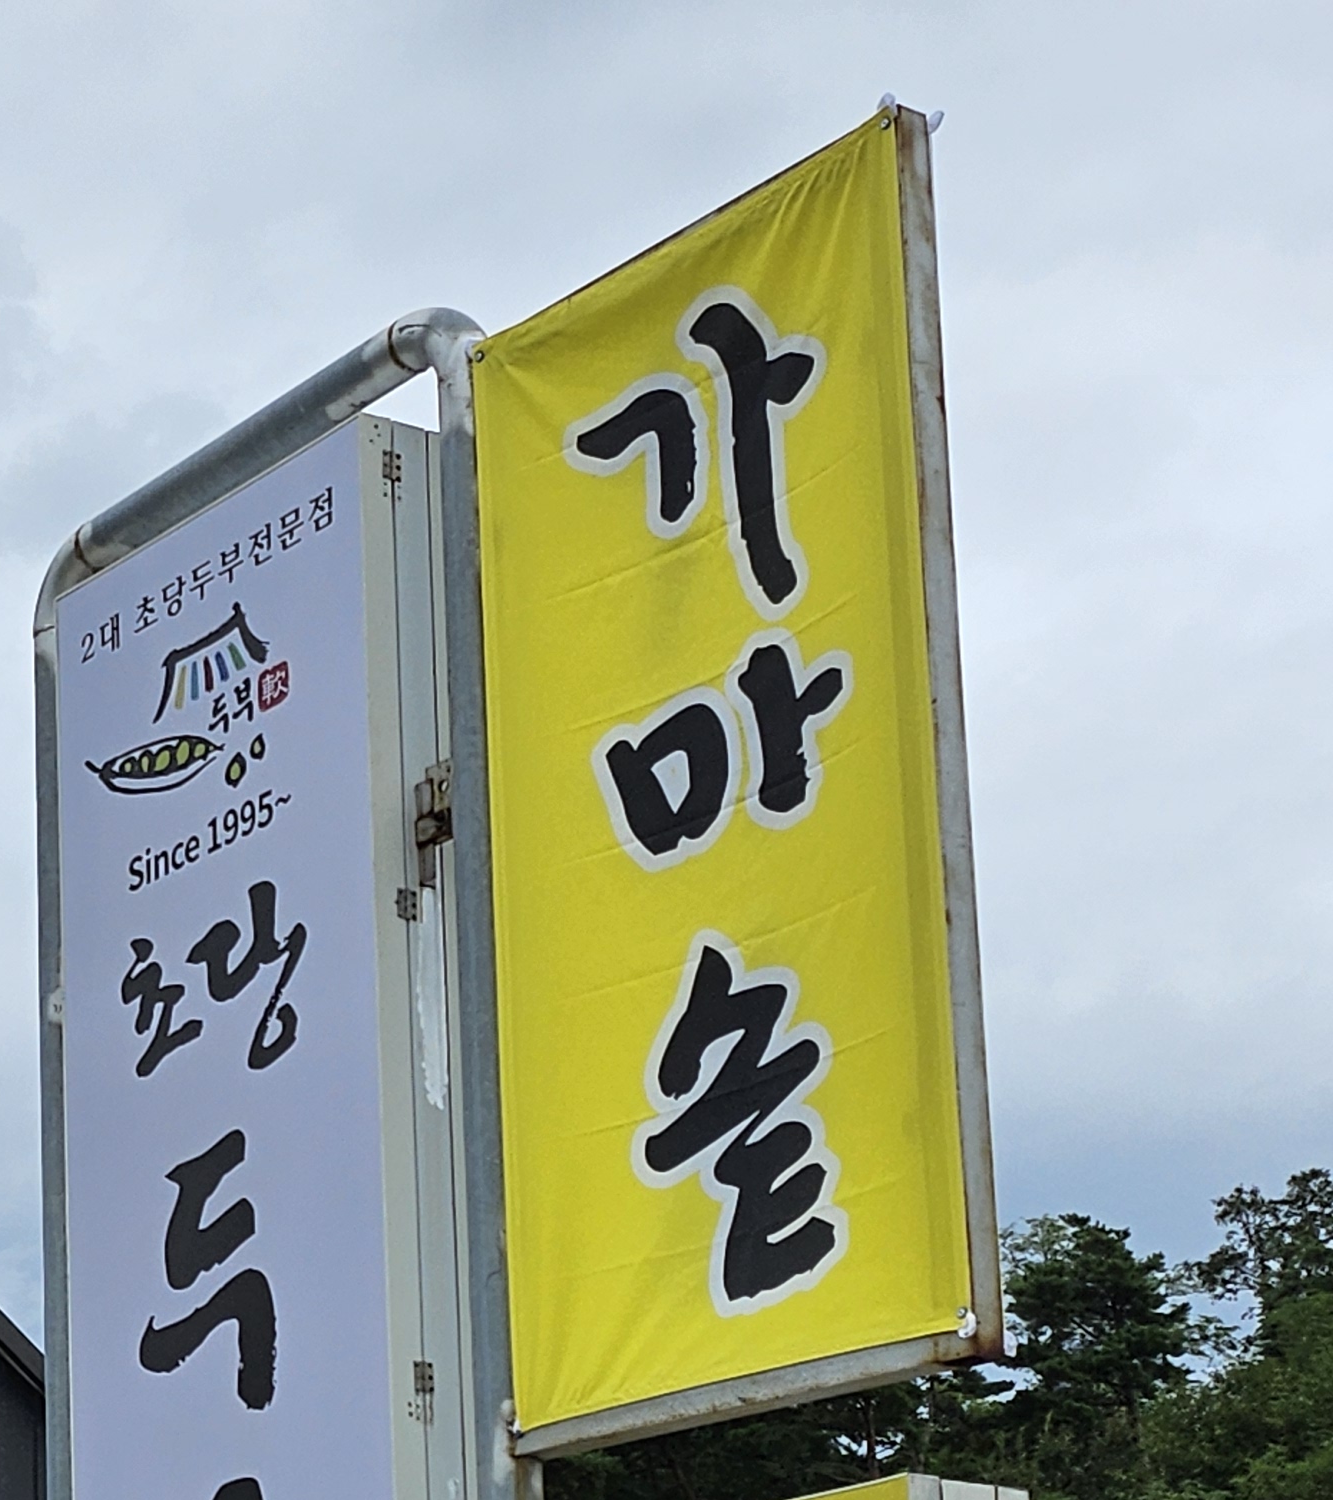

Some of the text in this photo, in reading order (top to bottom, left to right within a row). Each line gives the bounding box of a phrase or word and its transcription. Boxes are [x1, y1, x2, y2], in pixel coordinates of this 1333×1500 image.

[81, 487, 334, 664] 2대 초당두부전문점
[208, 677, 253, 733] 두부
[128, 790, 292, 892] Since 1995~
[576, 302, 845, 1302] 가마솥
[121, 881, 307, 1078] 초당
